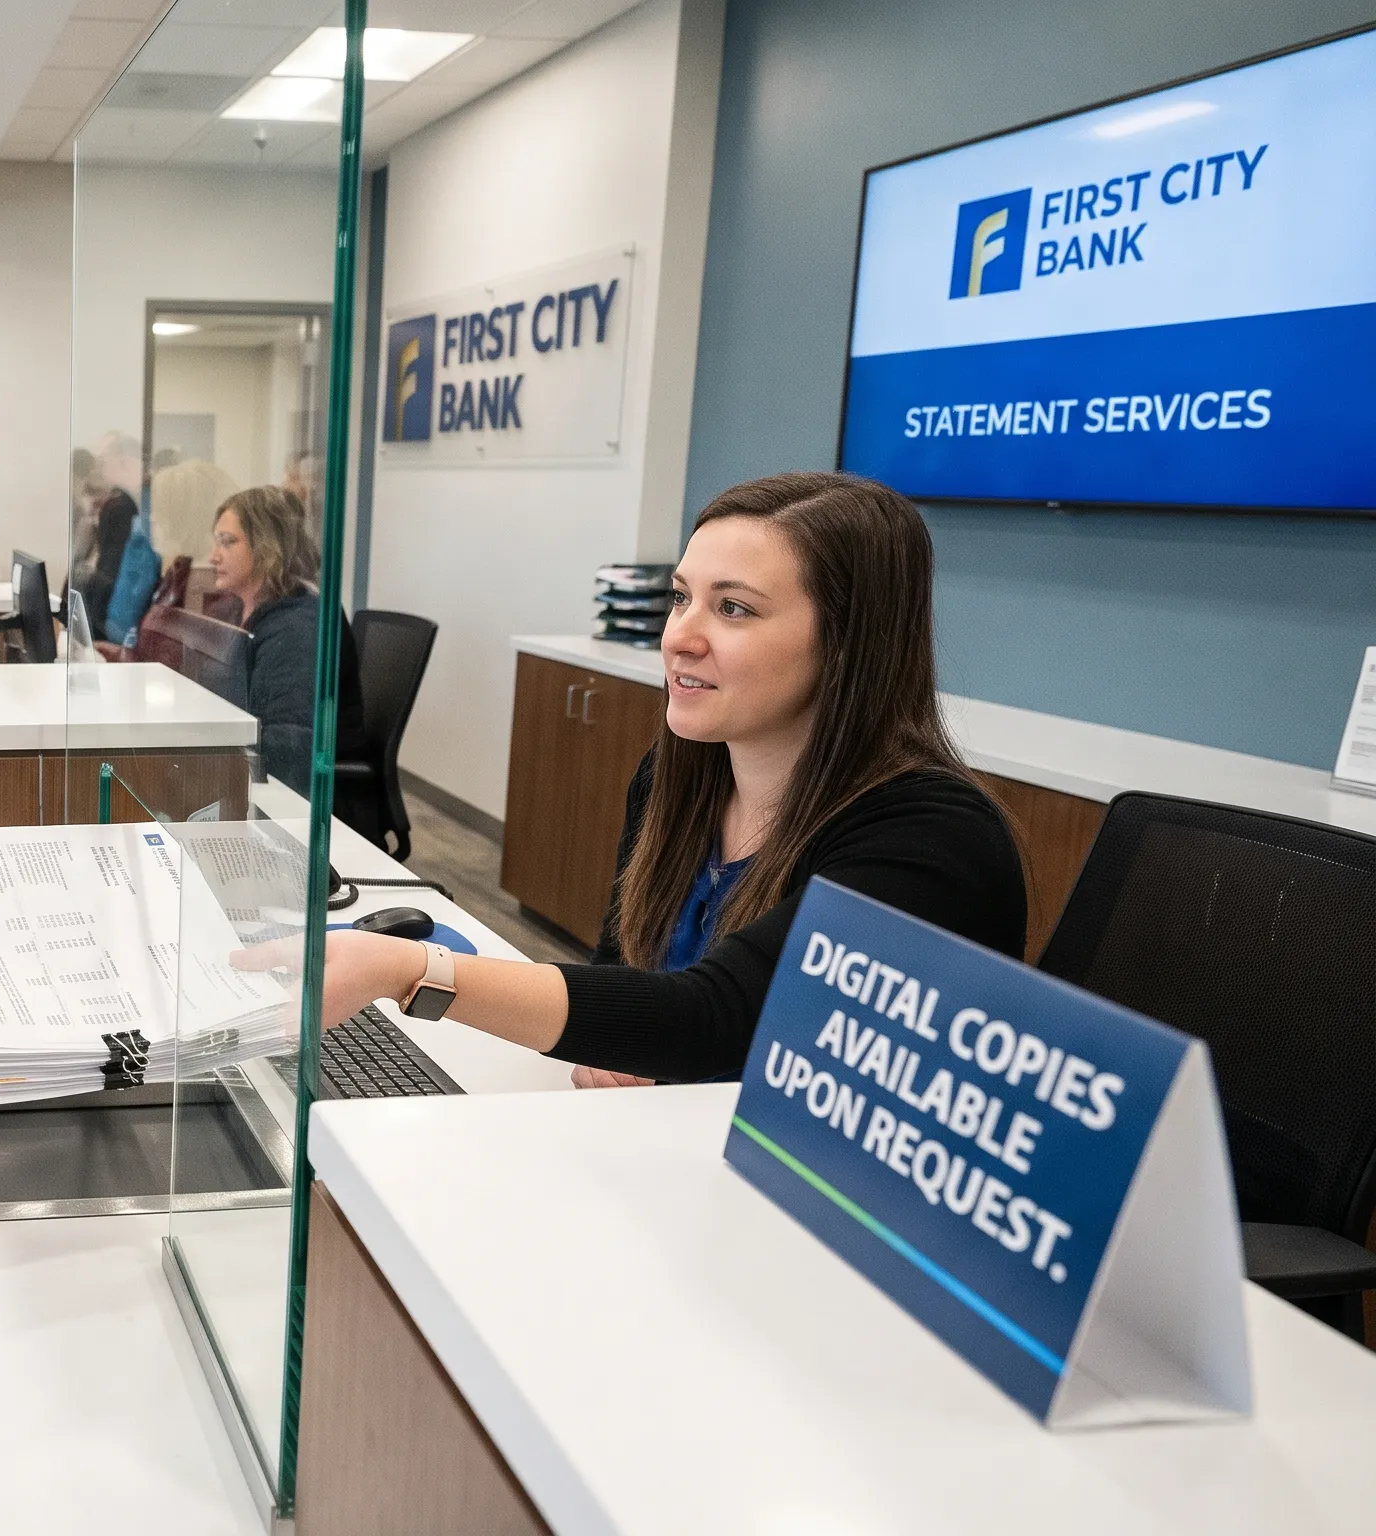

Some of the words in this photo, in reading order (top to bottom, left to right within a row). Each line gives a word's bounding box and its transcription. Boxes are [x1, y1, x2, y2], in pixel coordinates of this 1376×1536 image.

[1040, 170, 1151, 230] FIRST
[1160, 144, 1269, 205] CITY
[1035, 222, 1148, 277] BANK
[442, 301, 525, 368] FIRST
[531, 278, 620, 353] CITY
[395, 337, 420, 441] BANK
[904, 398, 1078, 438] STATEMENT
[1083, 388, 1273, 434] SERVICES
[800, 931, 941, 1041] DIGITAL
[948, 1007, 1125, 1131] COPIES
[815, 1009, 1044, 1174] AVAILABLE
[764, 1041, 867, 1139] UPON
[862, 1104, 1072, 1283] REQUEST.
